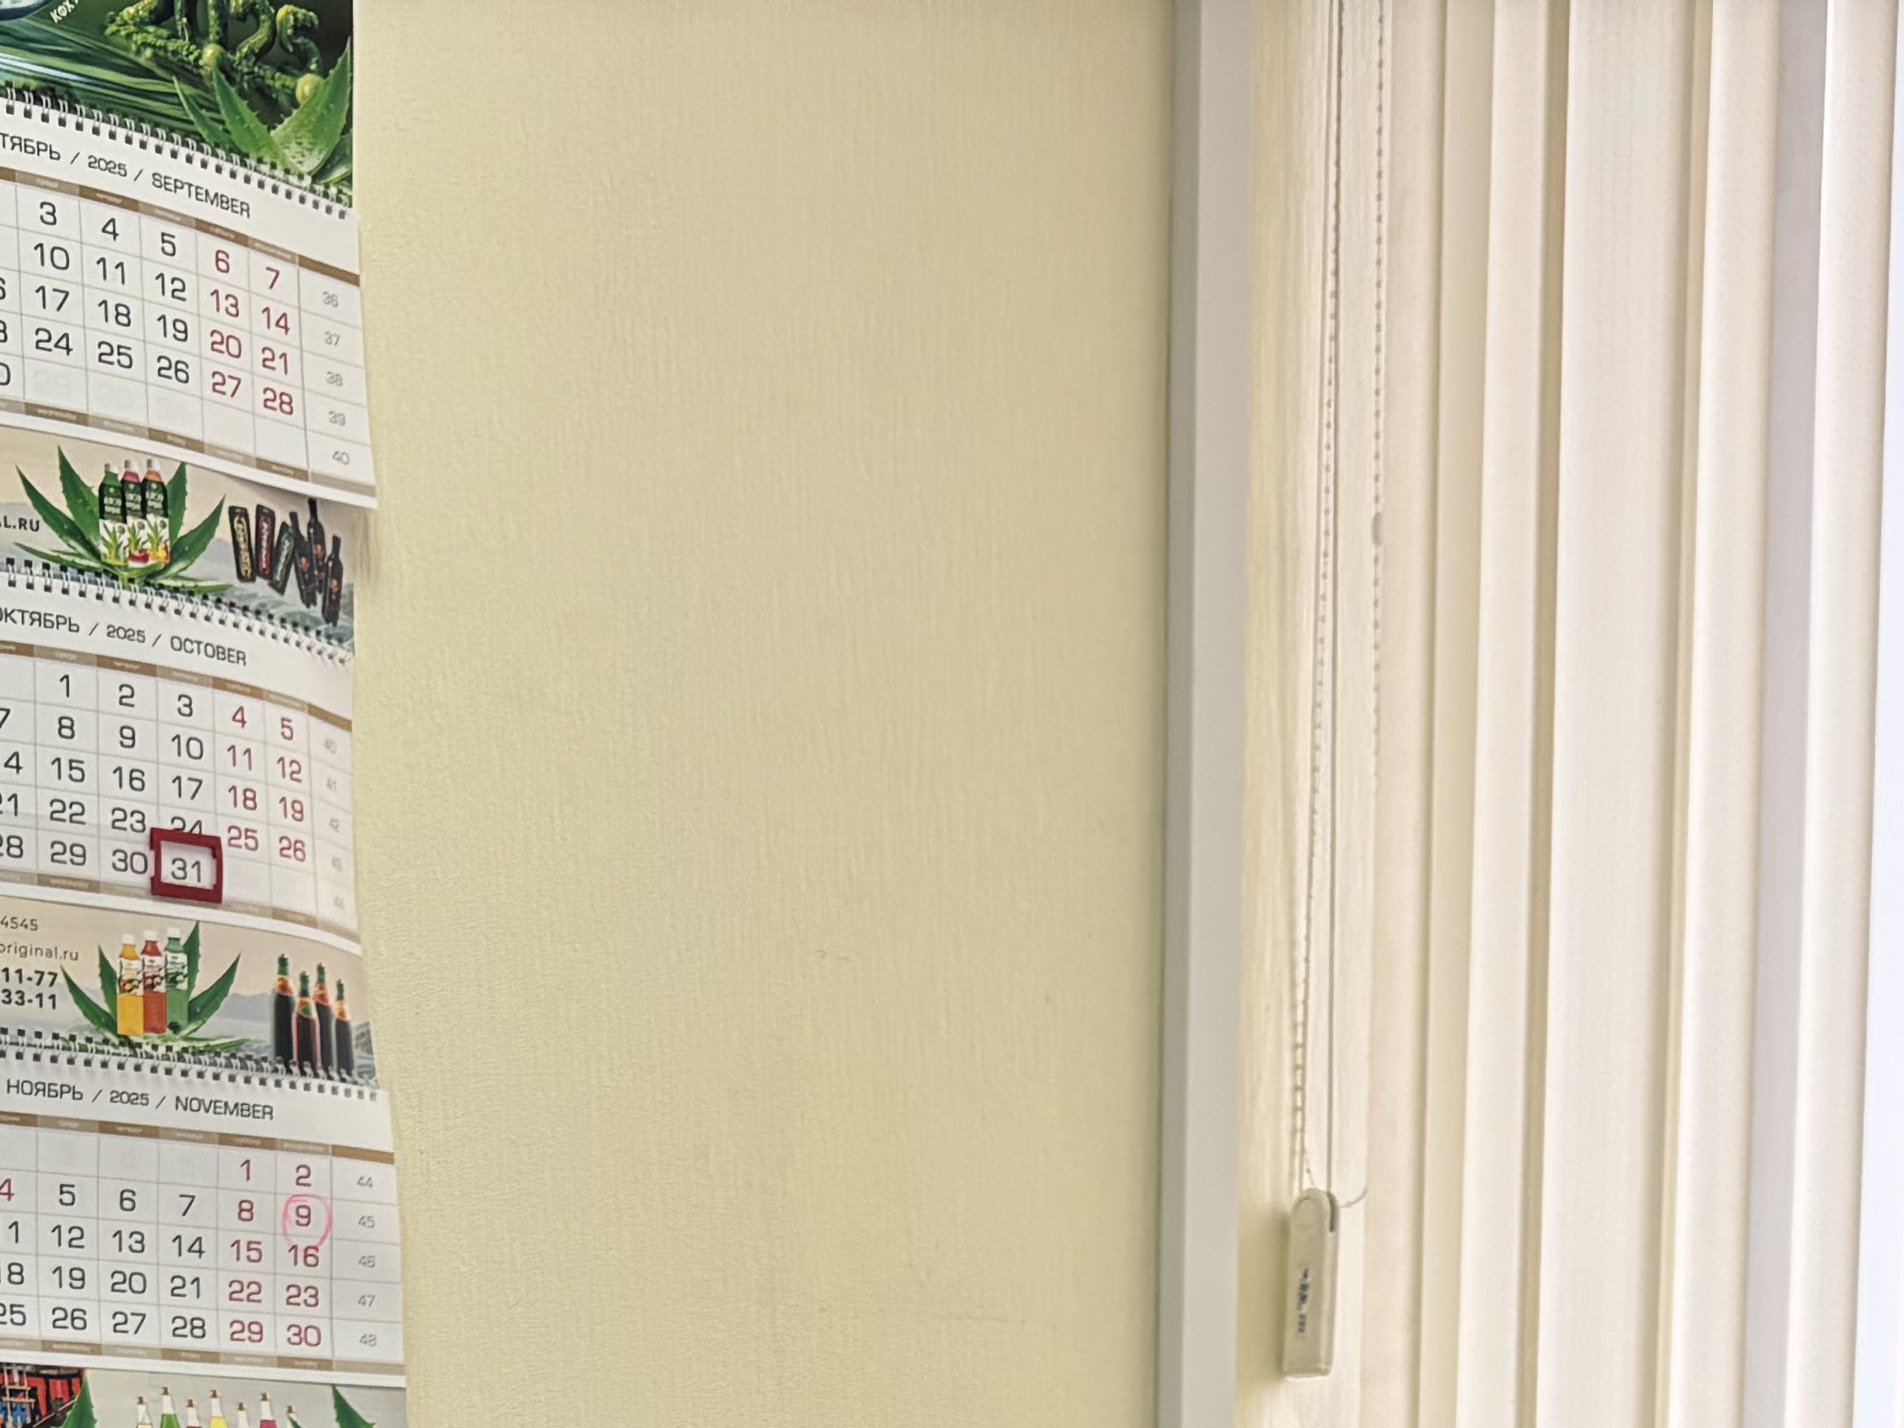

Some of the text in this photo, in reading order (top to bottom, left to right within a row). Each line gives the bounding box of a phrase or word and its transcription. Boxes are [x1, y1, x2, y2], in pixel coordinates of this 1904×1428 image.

[87, 154, 128, 179] 2025
[151, 171, 251, 220] SEPTEMBER
[40, 201, 57, 226] 3
[101, 218, 119, 241] 4
[161, 232, 176, 257] 5
[215, 249, 230, 273] 6
[266, 267, 280, 290] 7
[35, 327, 73, 356] 24
[98, 341, 133, 369] 25
[157, 355, 189, 384] 26
[212, 371, 241, 398] 27
[263, 387, 293, 415] 28
[106, 623, 146, 645] 2025
[170, 635, 247, 667] OCTOBER
[50, 840, 86, 866] 29
[112, 849, 148, 875] 30
[171, 858, 201, 883] 31
[6, 1078, 274, 1121] НОЯБРЬ 2025 NOVEMBER
[59, 1184, 75, 1206] 5
[119, 1189, 136, 1211] 6
[179, 1194, 196, 1216] 7
[238, 1200, 254, 1222] 8
[295, 1205, 311, 1227] 9
